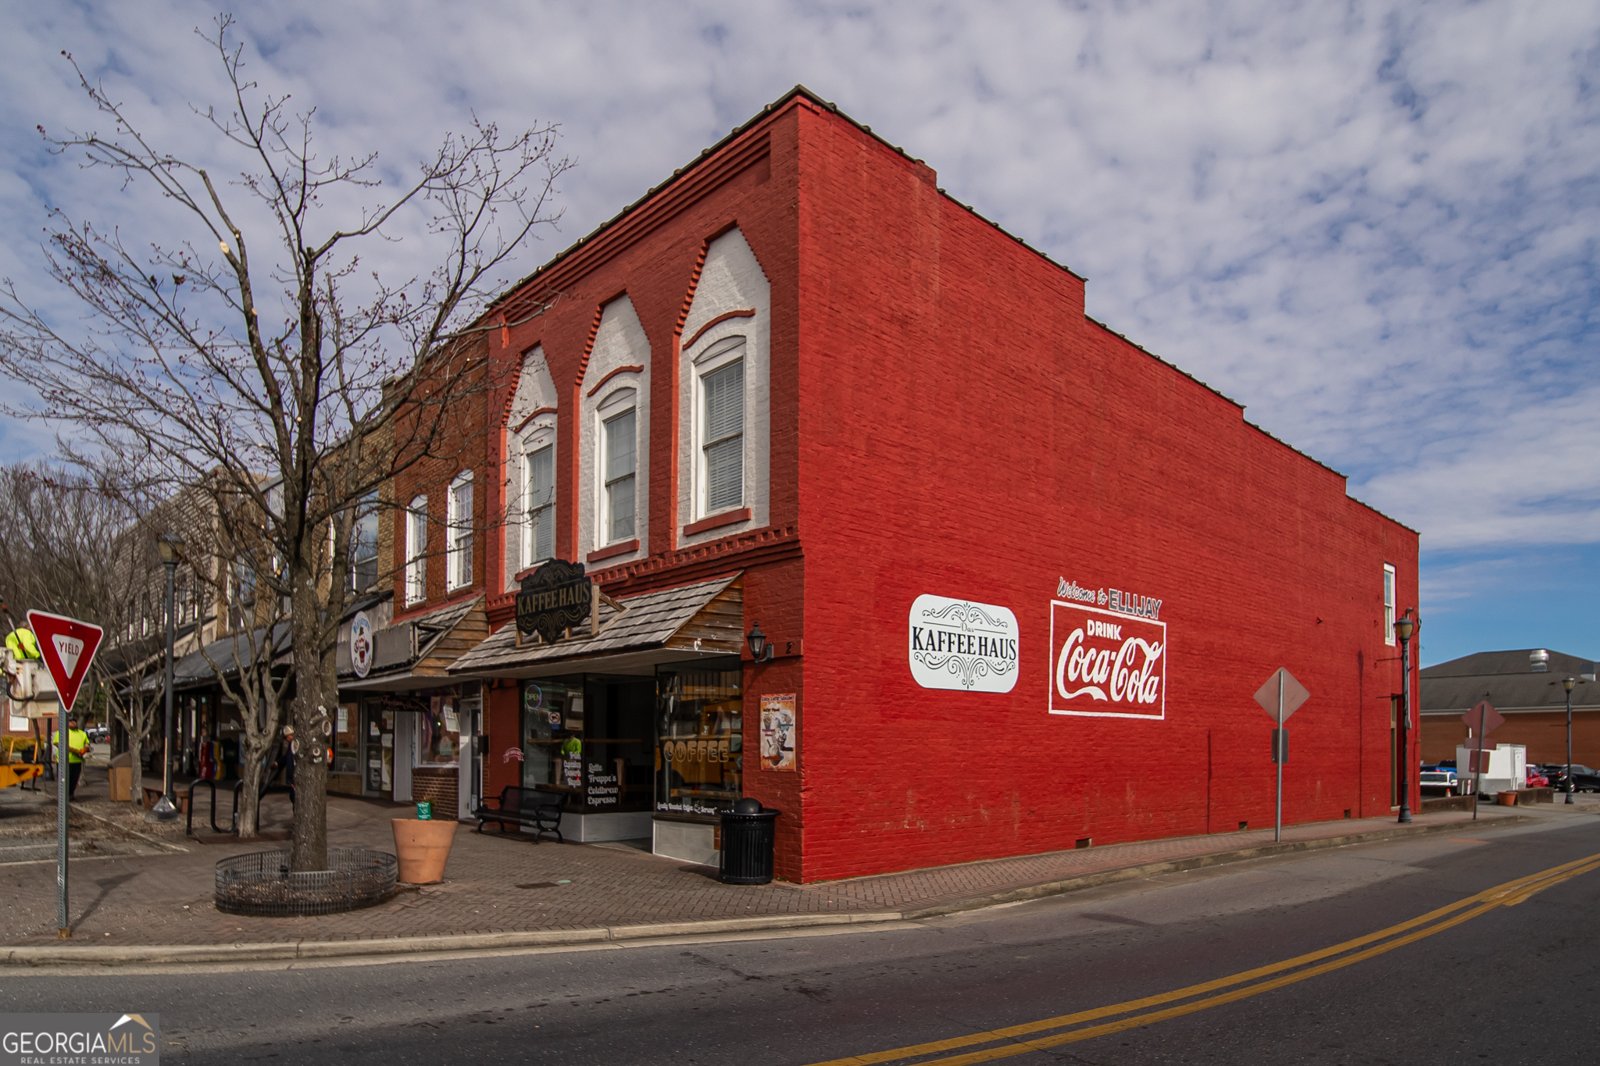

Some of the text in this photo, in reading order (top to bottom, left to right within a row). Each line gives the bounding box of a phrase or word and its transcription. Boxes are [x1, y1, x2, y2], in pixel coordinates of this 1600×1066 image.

[1057, 576, 1162, 619] Welcome to ELLIJAY
[1087, 619, 1122, 641] DRINK
[59, 641, 80, 656] YIELD
[1056, 628, 1164, 705] Coca-Cola
[664, 740, 729, 763] COFFEE
[587, 796, 617, 807] Espresso
